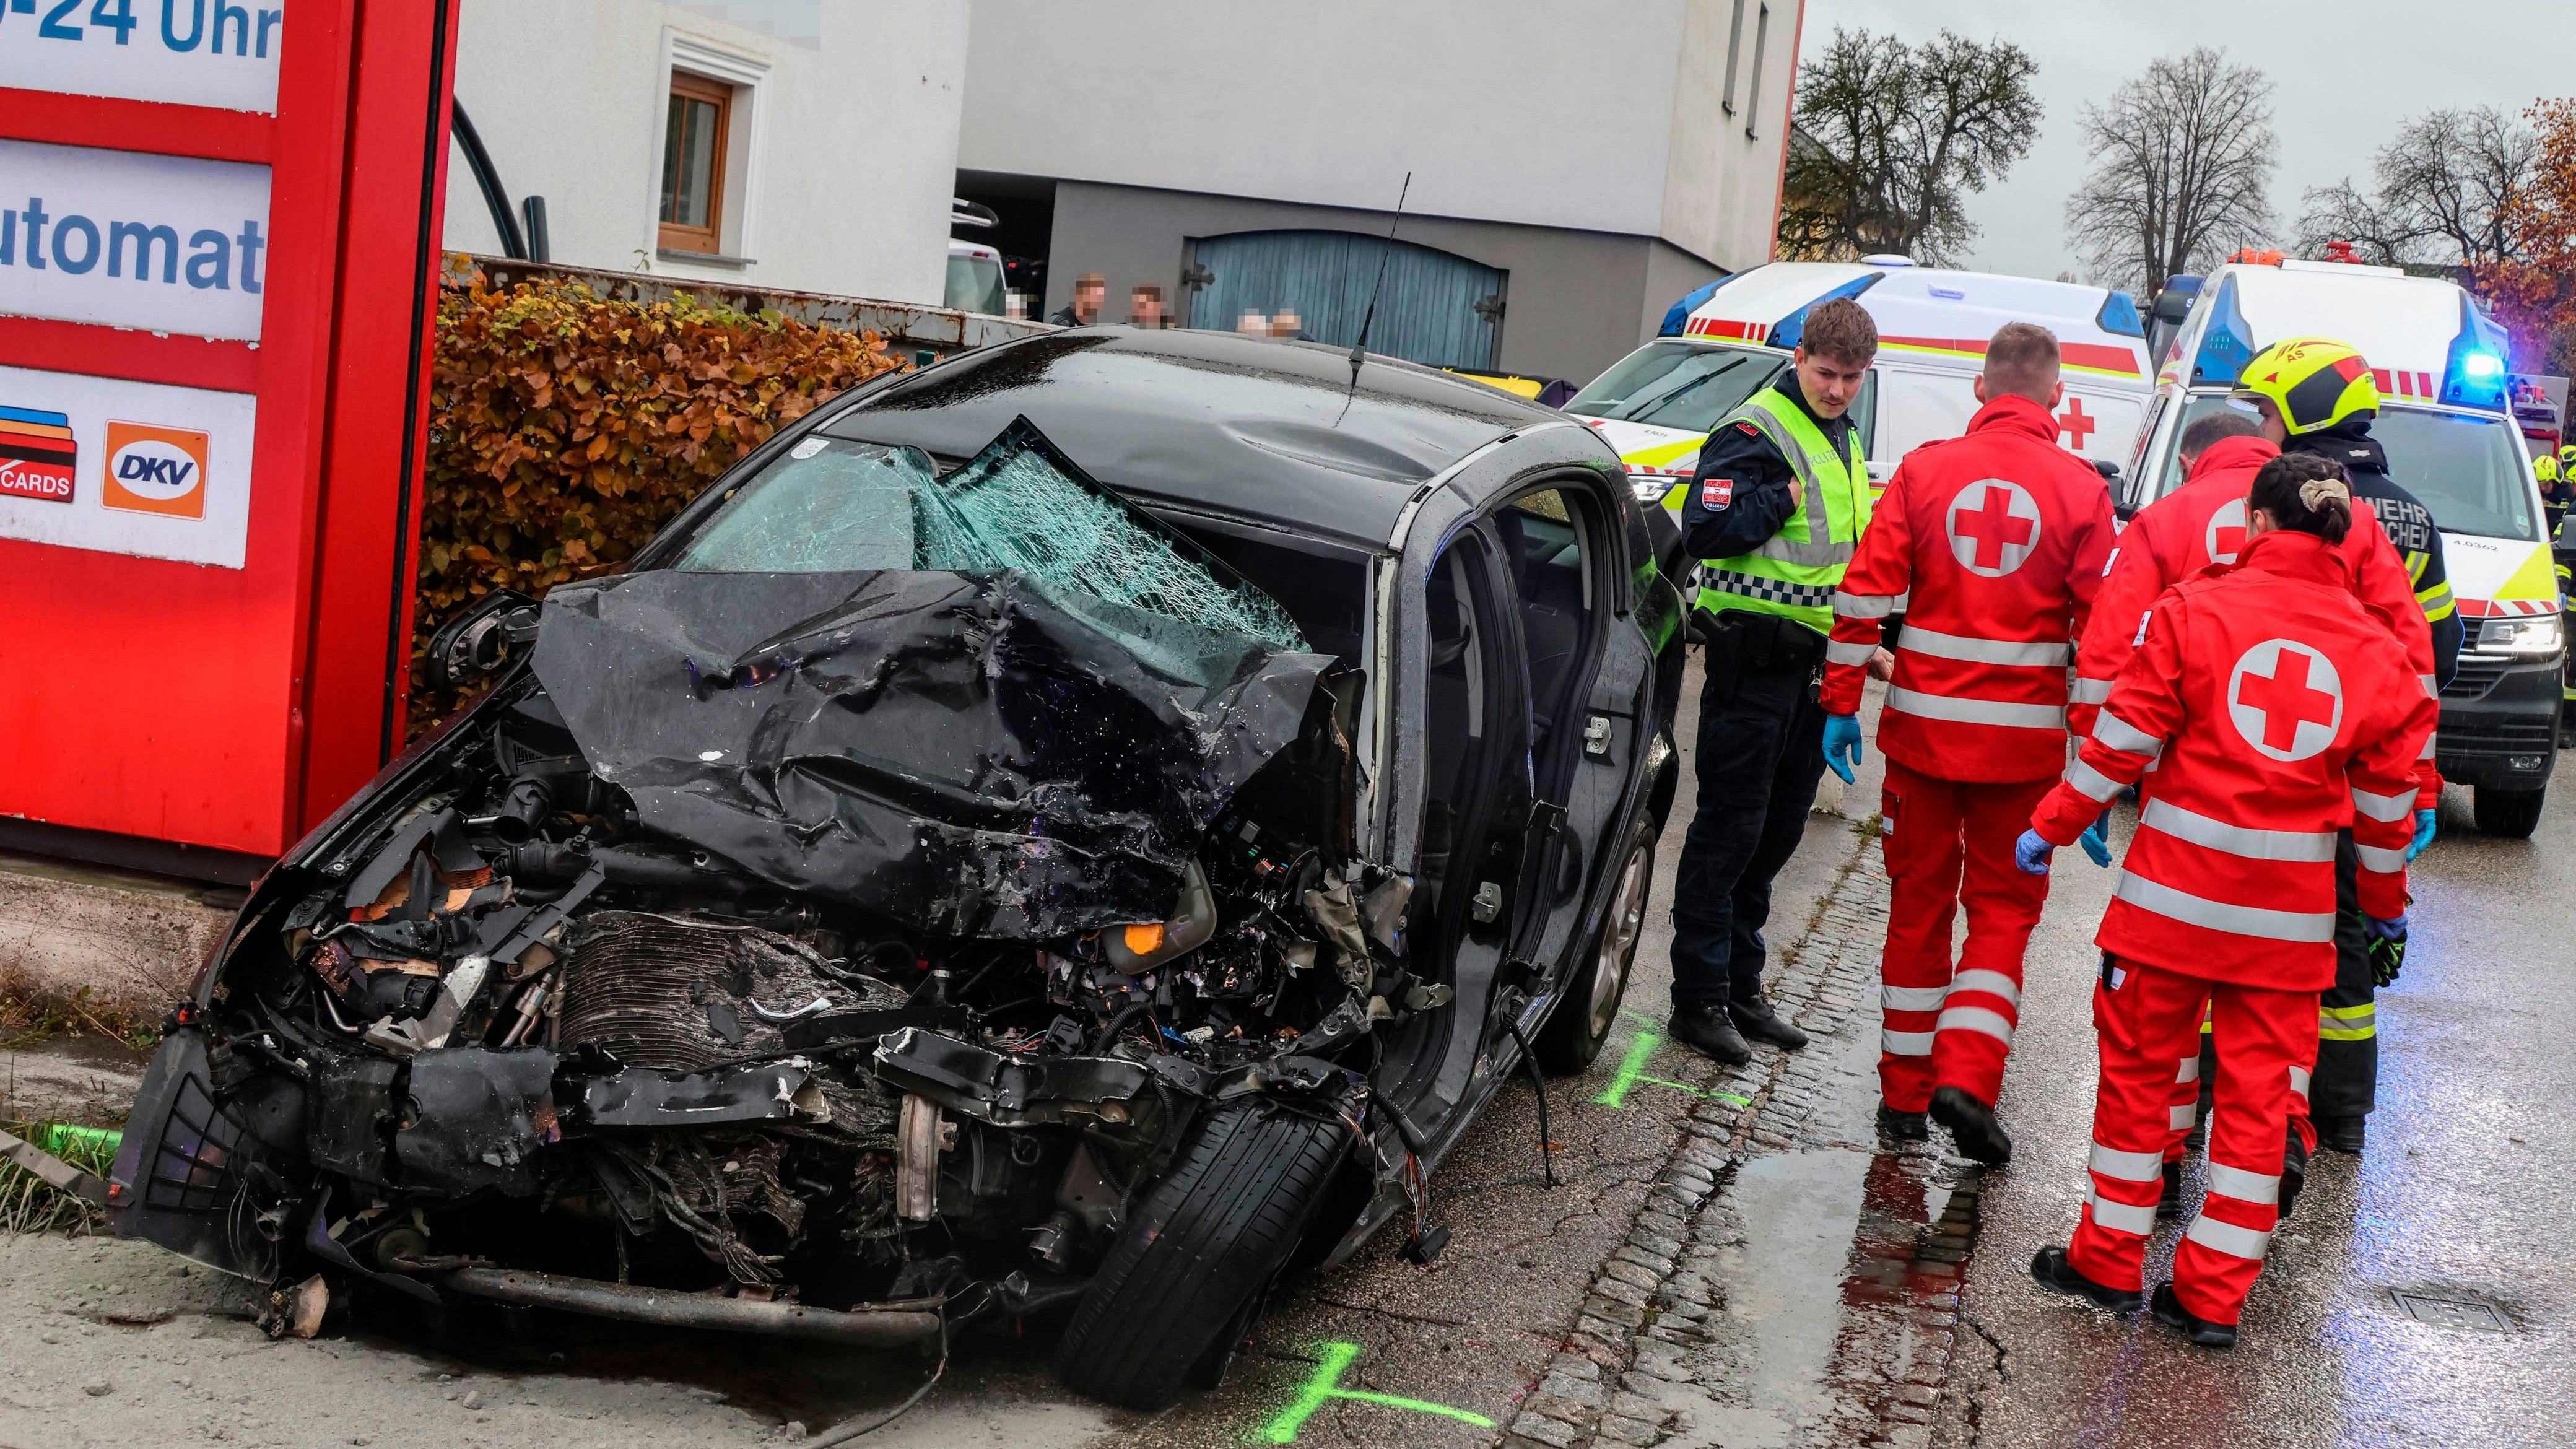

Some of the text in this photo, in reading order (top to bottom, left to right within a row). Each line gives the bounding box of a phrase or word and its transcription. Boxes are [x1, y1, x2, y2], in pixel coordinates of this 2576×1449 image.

[0, 0, 281, 58] -24 Uhr
[2287, 350, 2304, 363] AS
[1, 470, 70, 495] CARDS
[118, 455, 194, 485] DKV
[2377, 521, 2430, 549] CHEN
